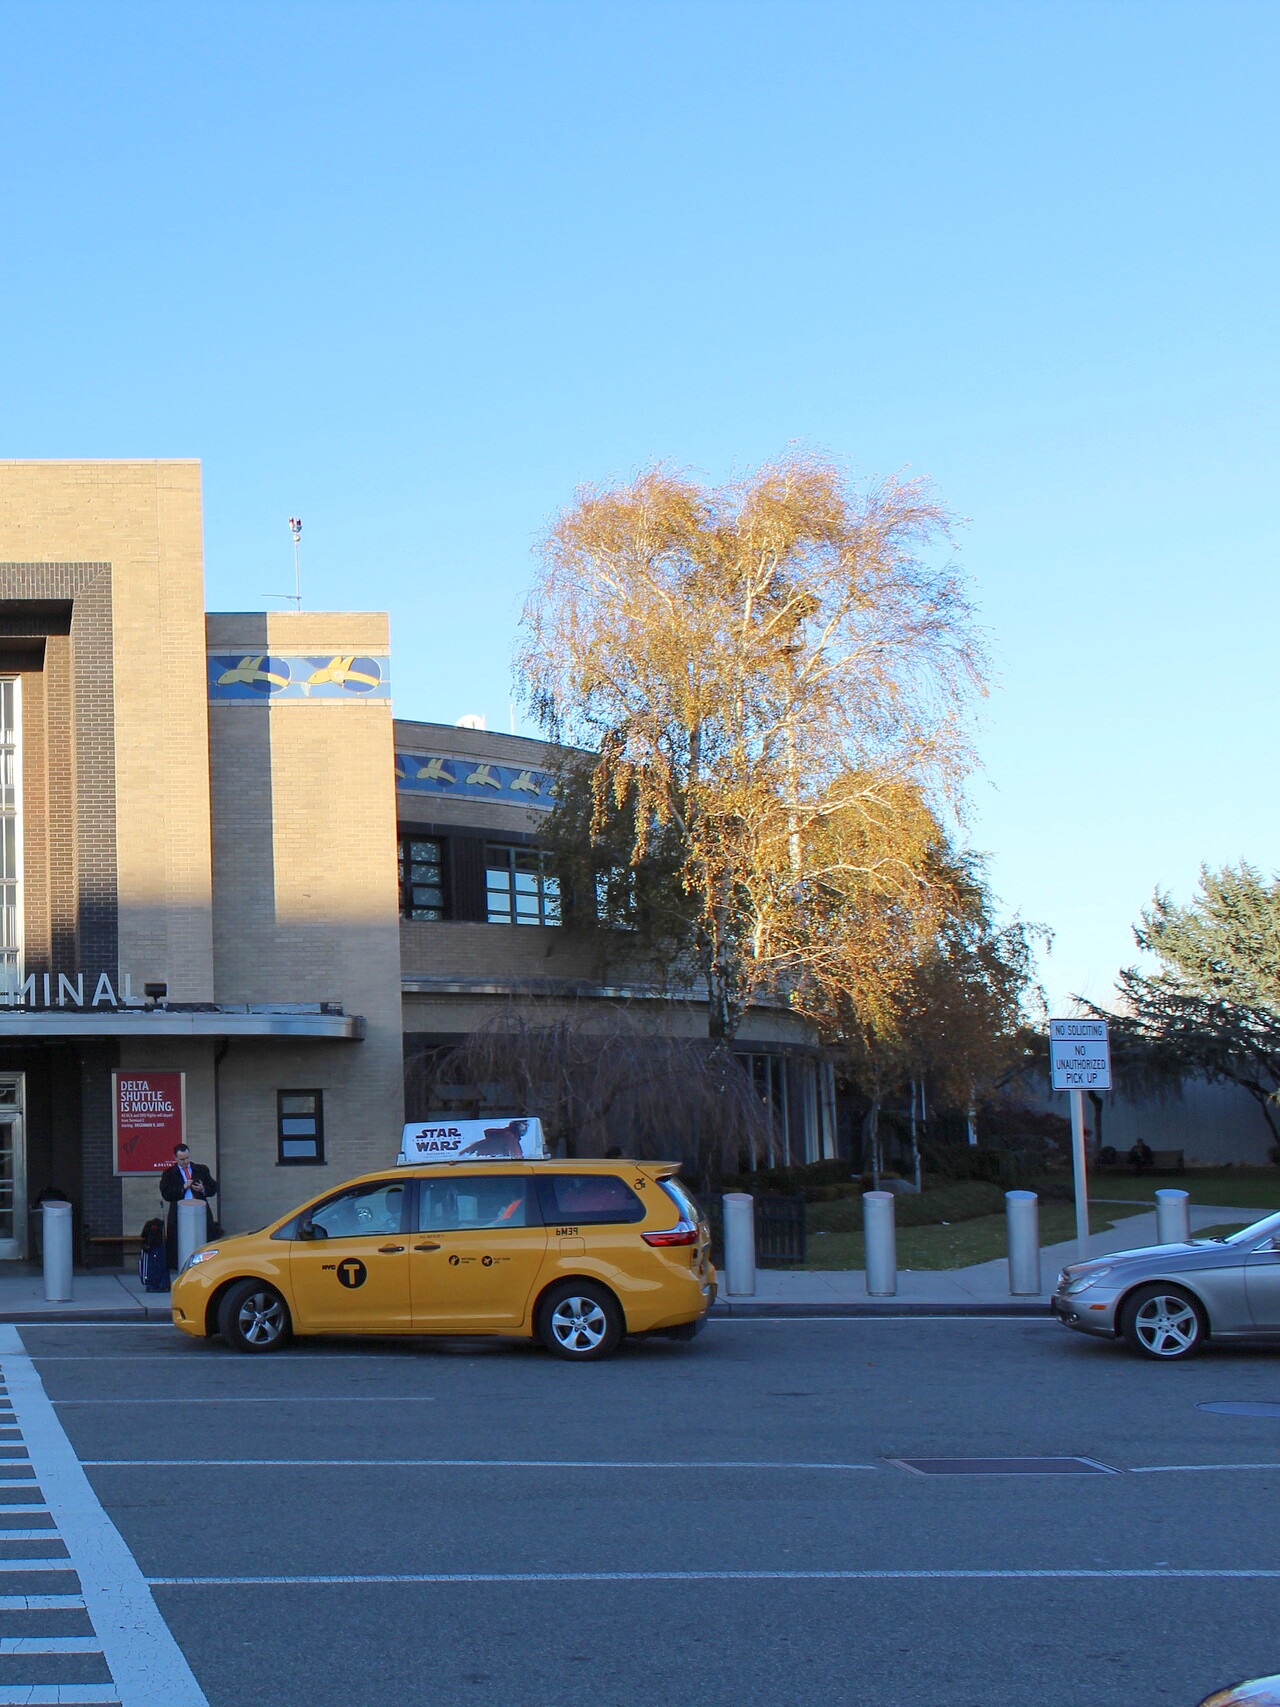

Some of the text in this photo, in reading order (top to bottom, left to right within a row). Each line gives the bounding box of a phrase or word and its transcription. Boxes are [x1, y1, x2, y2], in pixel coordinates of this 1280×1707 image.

[1055, 1025, 1103, 1036] NO SOLICITING
[1074, 1045, 1086, 1056] NO
[1056, 1059, 1106, 1070] UNAUTHORIZED
[1066, 1072, 1098, 1083] PICK UP
[121, 1081, 149, 1091] DELTA
[121, 1091, 163, 1101] SHUTTLE
[121, 1101, 175, 1112] IS MOVING.
[415, 1128, 461, 1139] STAR
[415, 1140, 461, 1152] WARS
[343, 1263, 360, 1285] T
